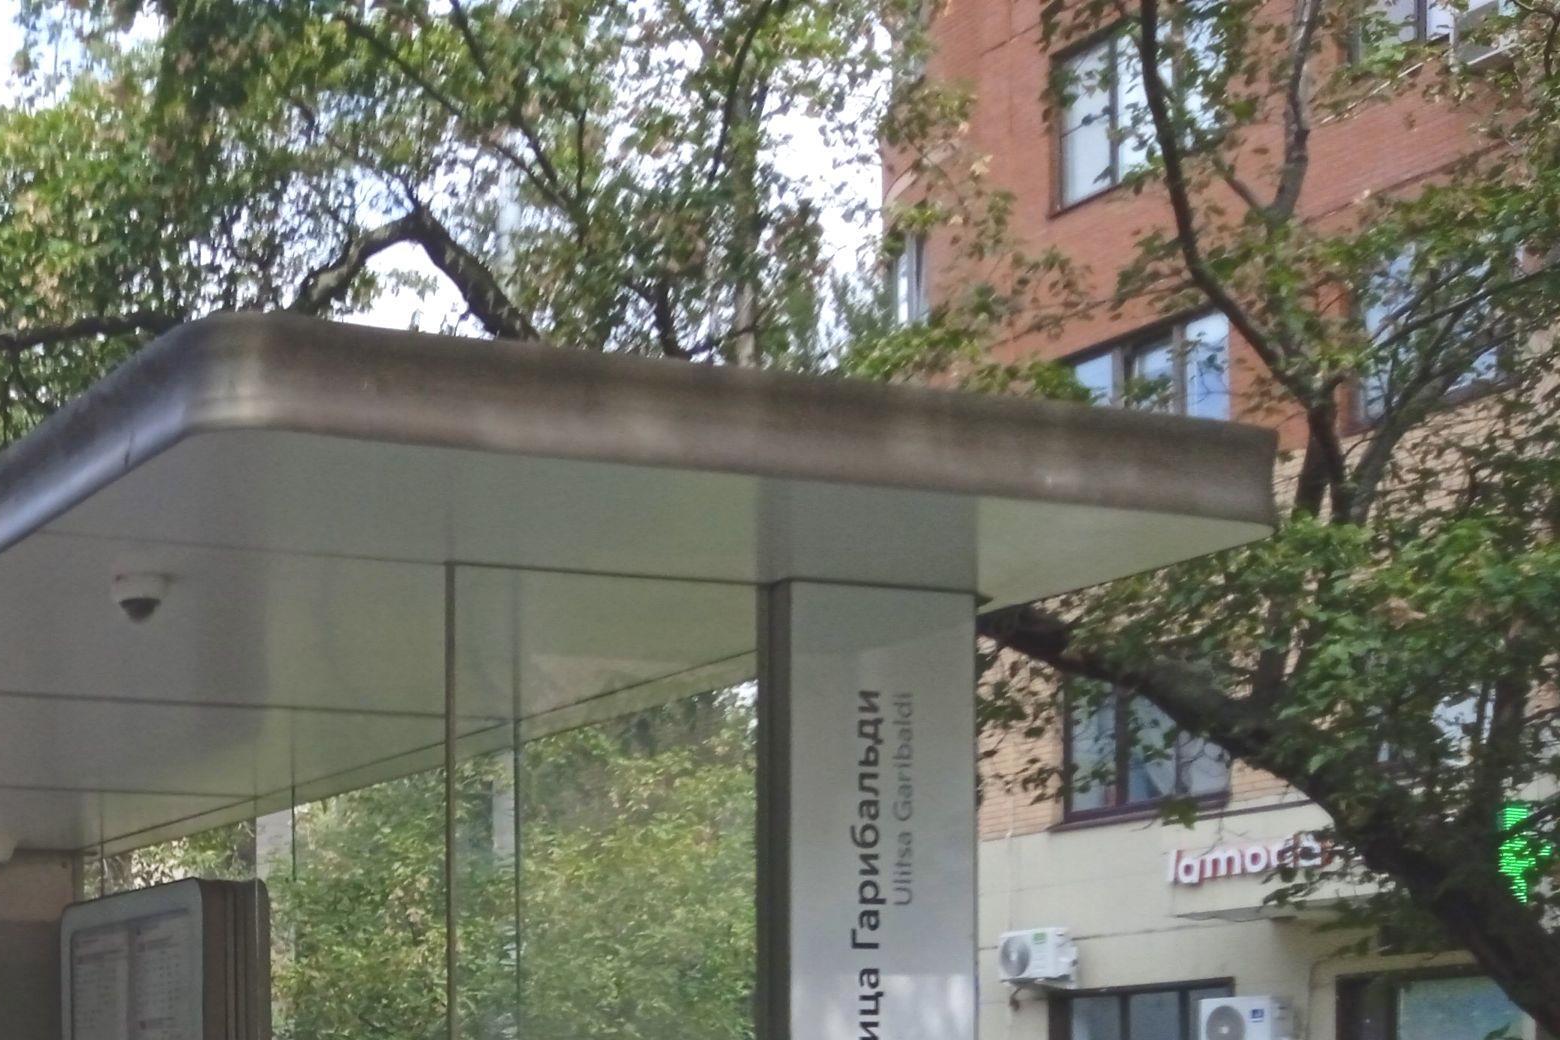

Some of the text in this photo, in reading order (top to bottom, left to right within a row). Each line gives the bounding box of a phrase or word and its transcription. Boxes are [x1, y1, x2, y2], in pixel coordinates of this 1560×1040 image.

[849, 690, 887, 949] Гарибальди
[892, 692, 914, 905] Ulitsa Garibaldi
